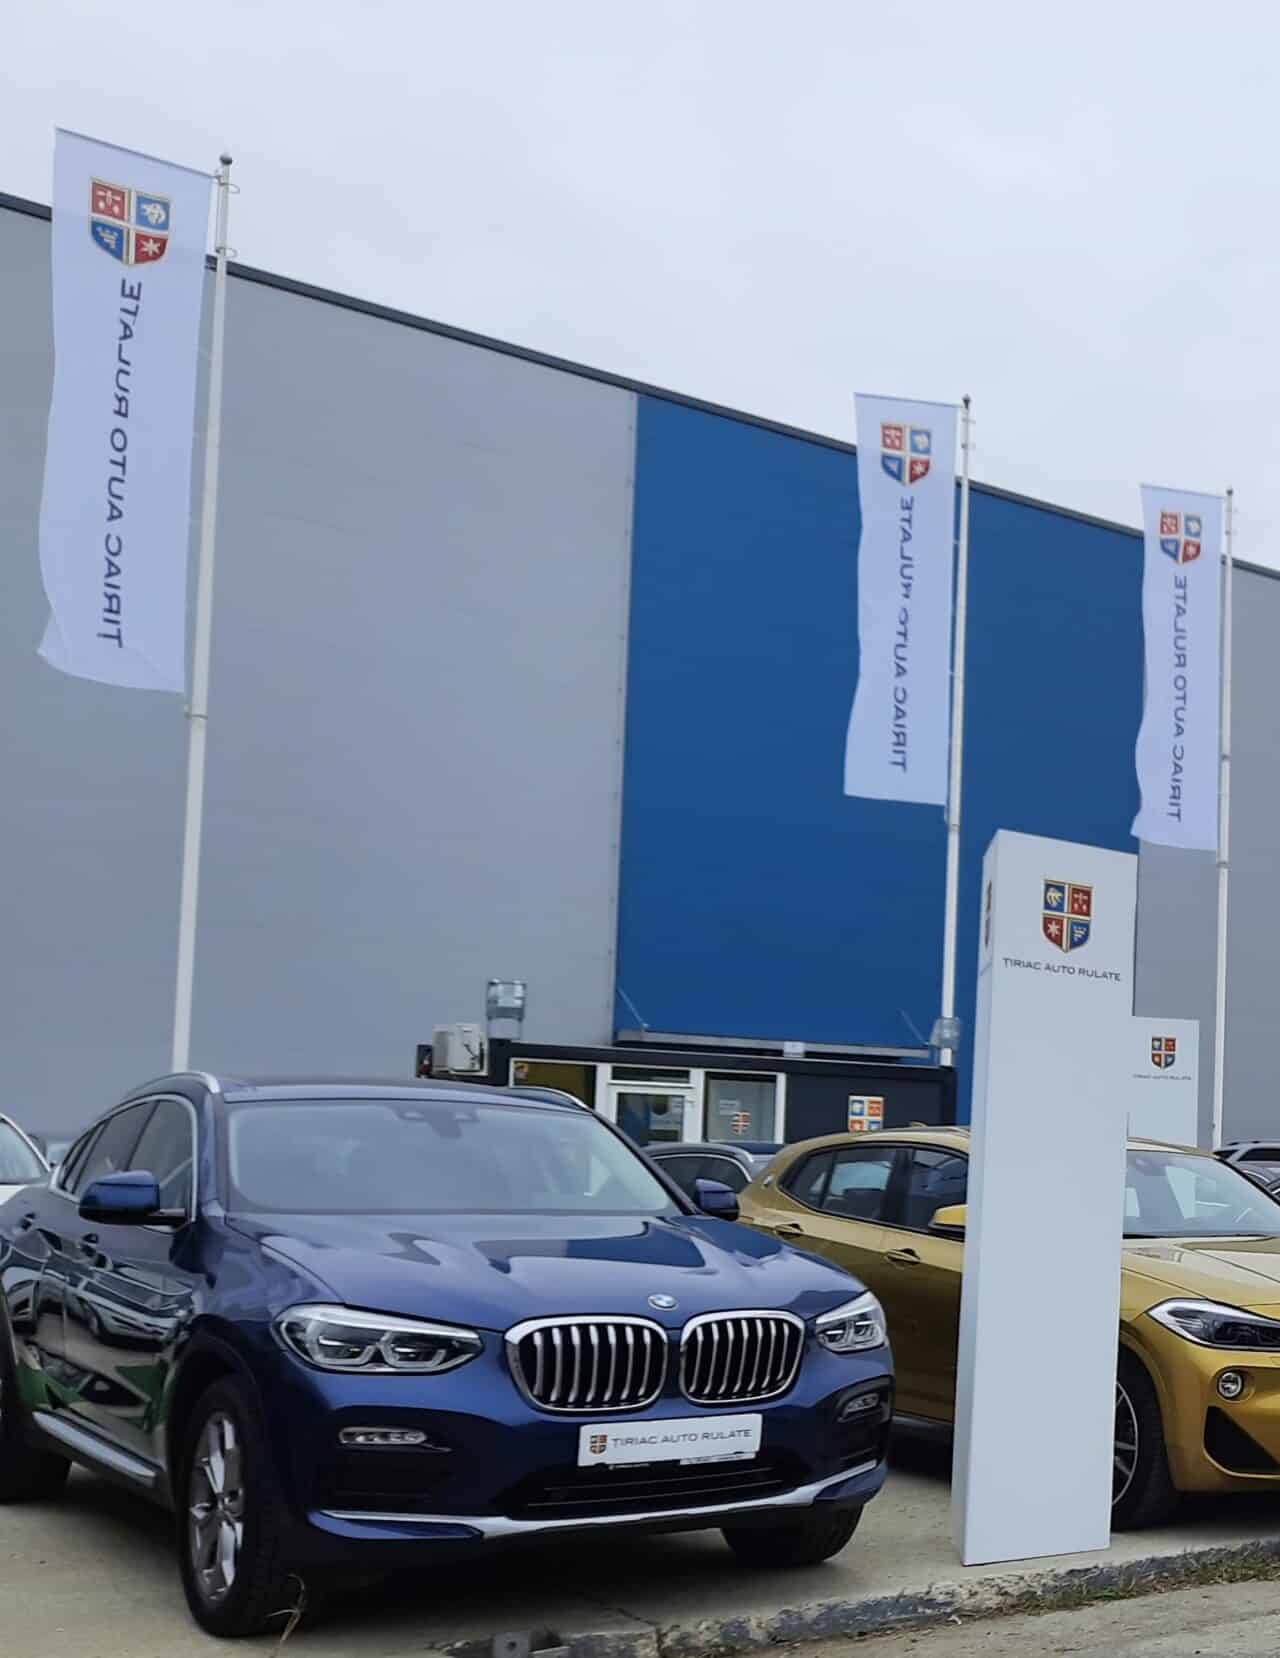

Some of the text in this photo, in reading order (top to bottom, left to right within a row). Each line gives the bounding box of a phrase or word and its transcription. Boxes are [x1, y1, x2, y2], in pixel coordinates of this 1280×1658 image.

[1003, 957, 1121, 981] TIRIAC AUTO RULATE
[612, 1429, 752, 1448] TIRIAC AUTO RULATE
